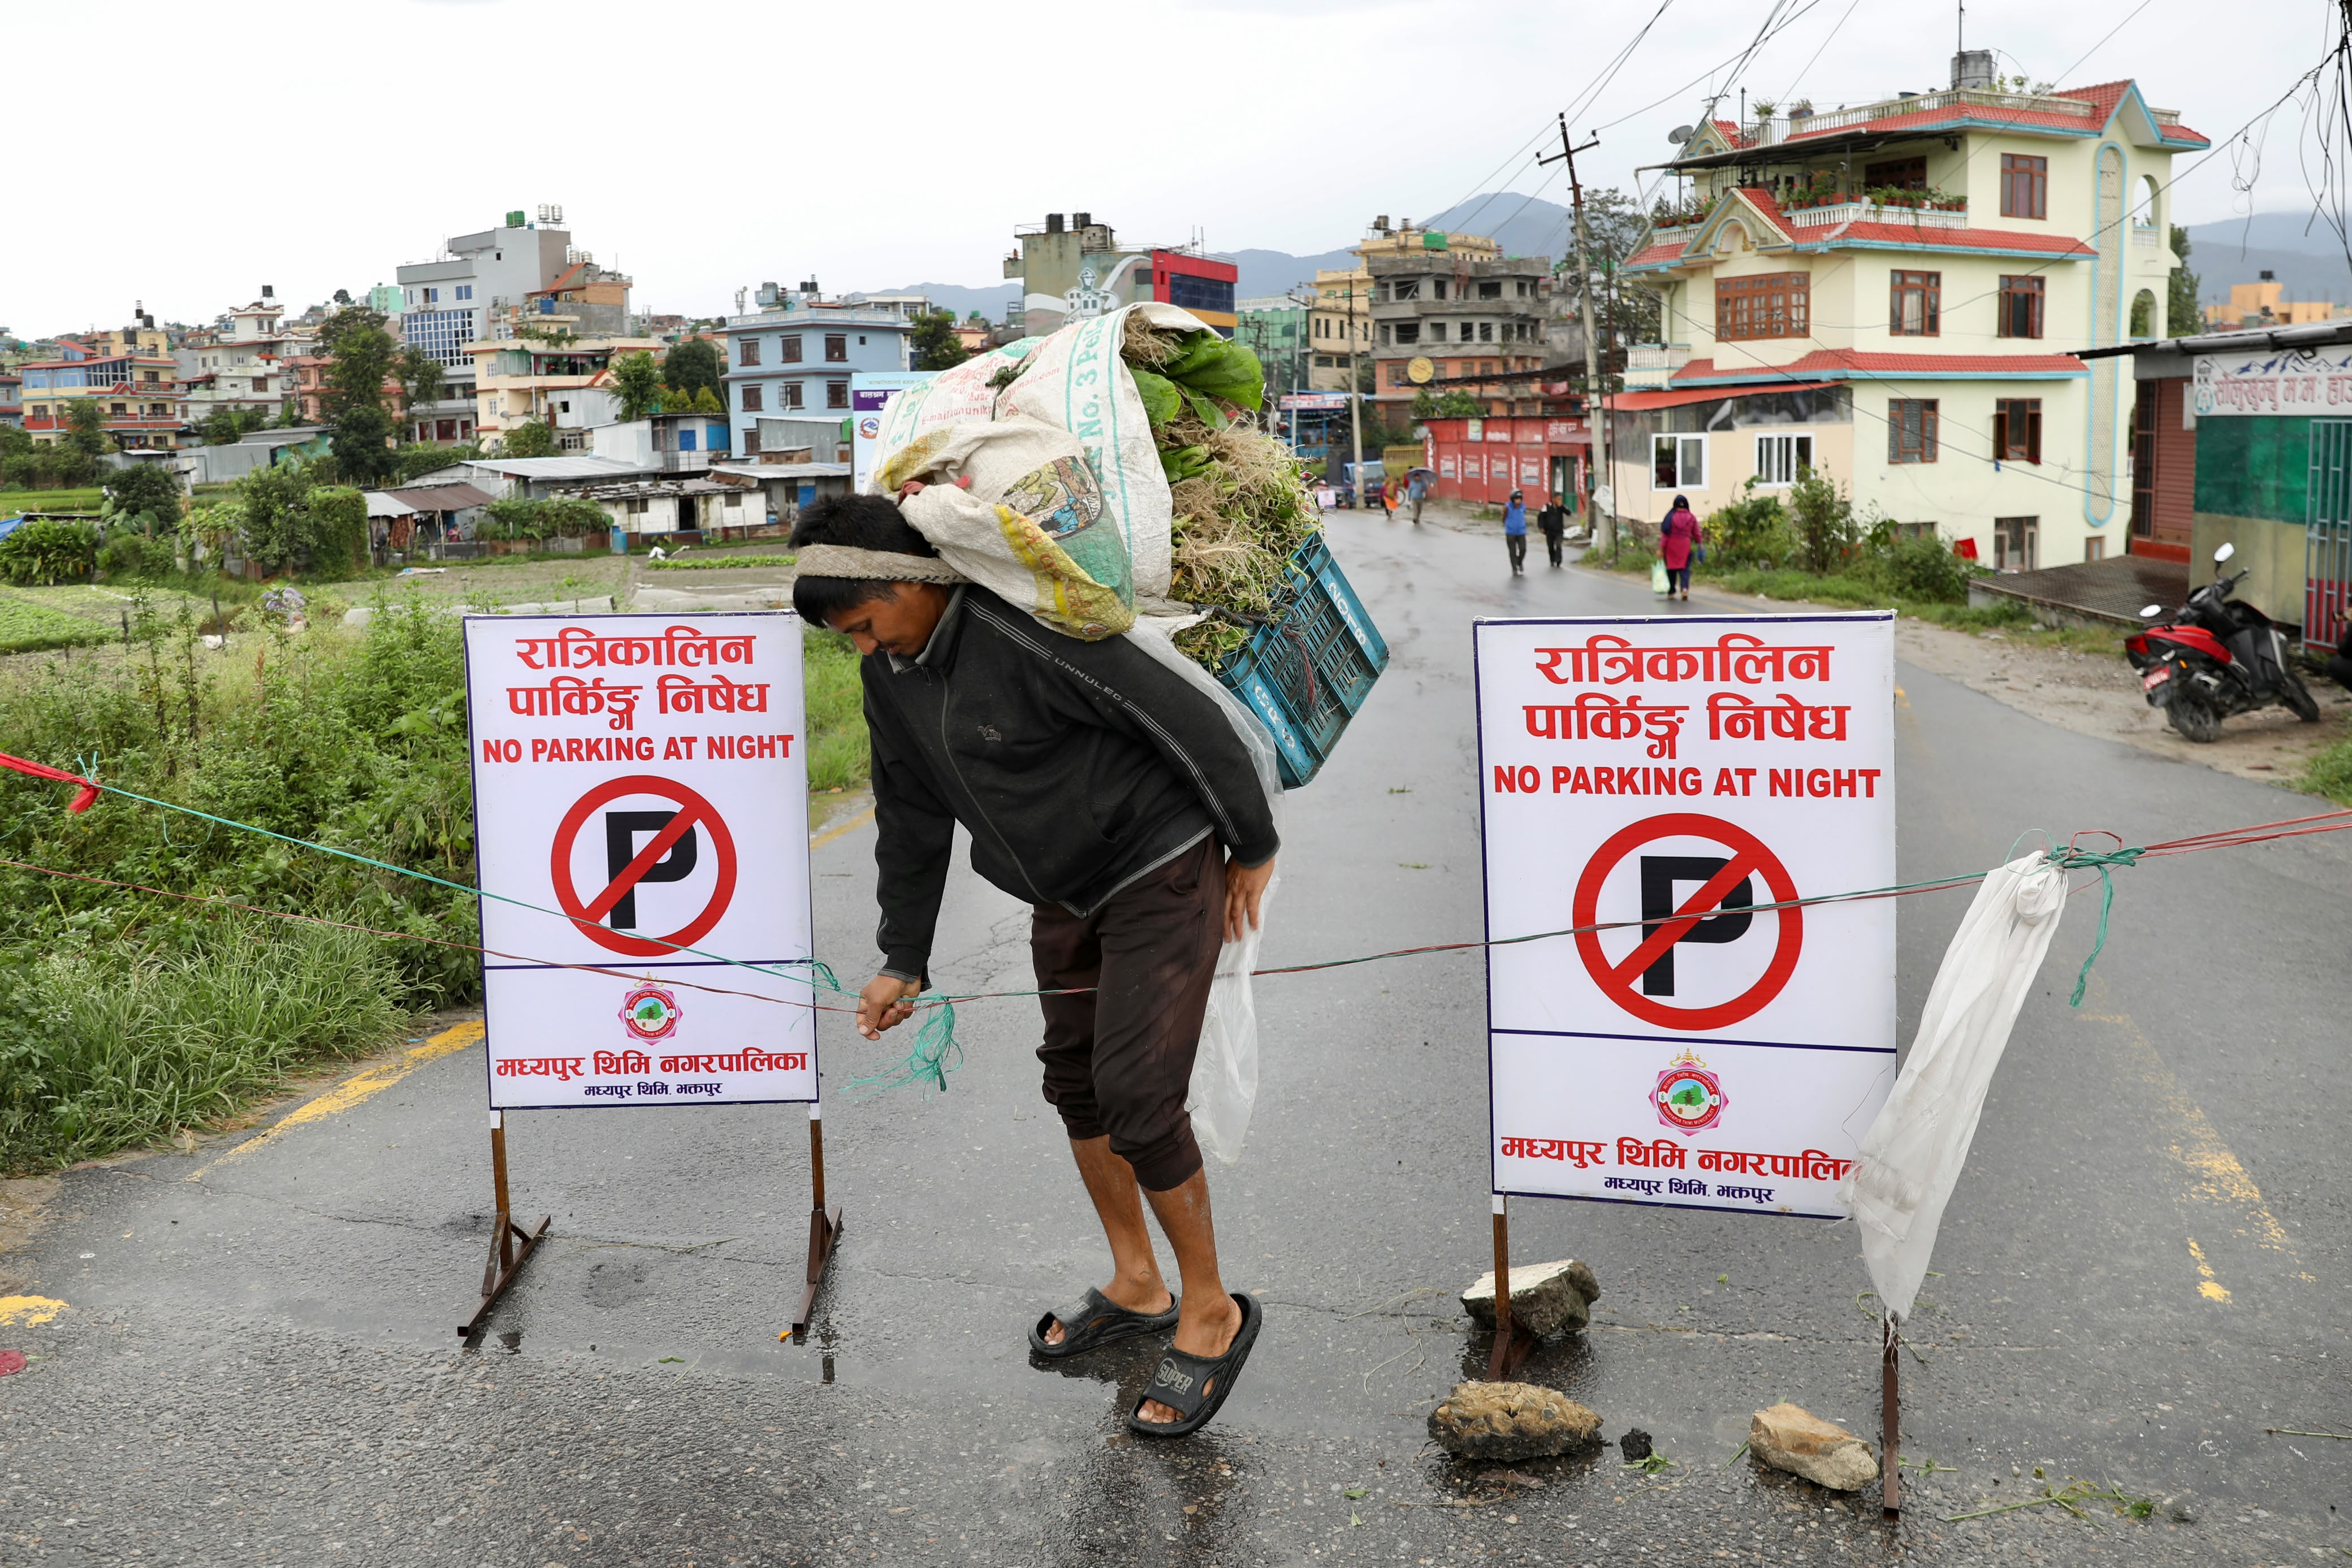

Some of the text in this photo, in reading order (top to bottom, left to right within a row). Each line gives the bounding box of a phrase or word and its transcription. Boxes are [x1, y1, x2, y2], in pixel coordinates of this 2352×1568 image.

[1328, 582, 1367, 646] 2018
[516, 625, 757, 670] रात्रिकालिन
[1534, 633, 1835, 685] रात्रिकालिन
[506, 674, 771, 731] पार्किङ्ग निषेध
[1522, 692, 1852, 760] पार्किङ्ग निषेध
[483, 734, 794, 763] NO PARKING AT NIGHT
[1494, 765, 1882, 798] NO PARKING AT NIGHT
[496, 1047, 807, 1081] मध्यपुर थिमि नगरपालिका
[584, 1084, 633, 1099] मध्यपुर
[676, 1082, 723, 1097] भक्तपुर
[1502, 1137, 1608, 1169] मध्यपुर
[1617, 1137, 1688, 1170] थिमि
[1604, 1176, 1664, 1196] मध्यपुर
[1717, 1185, 1775, 1204] भक्तपुर
[1157, 1363, 1194, 1392] SUPER
